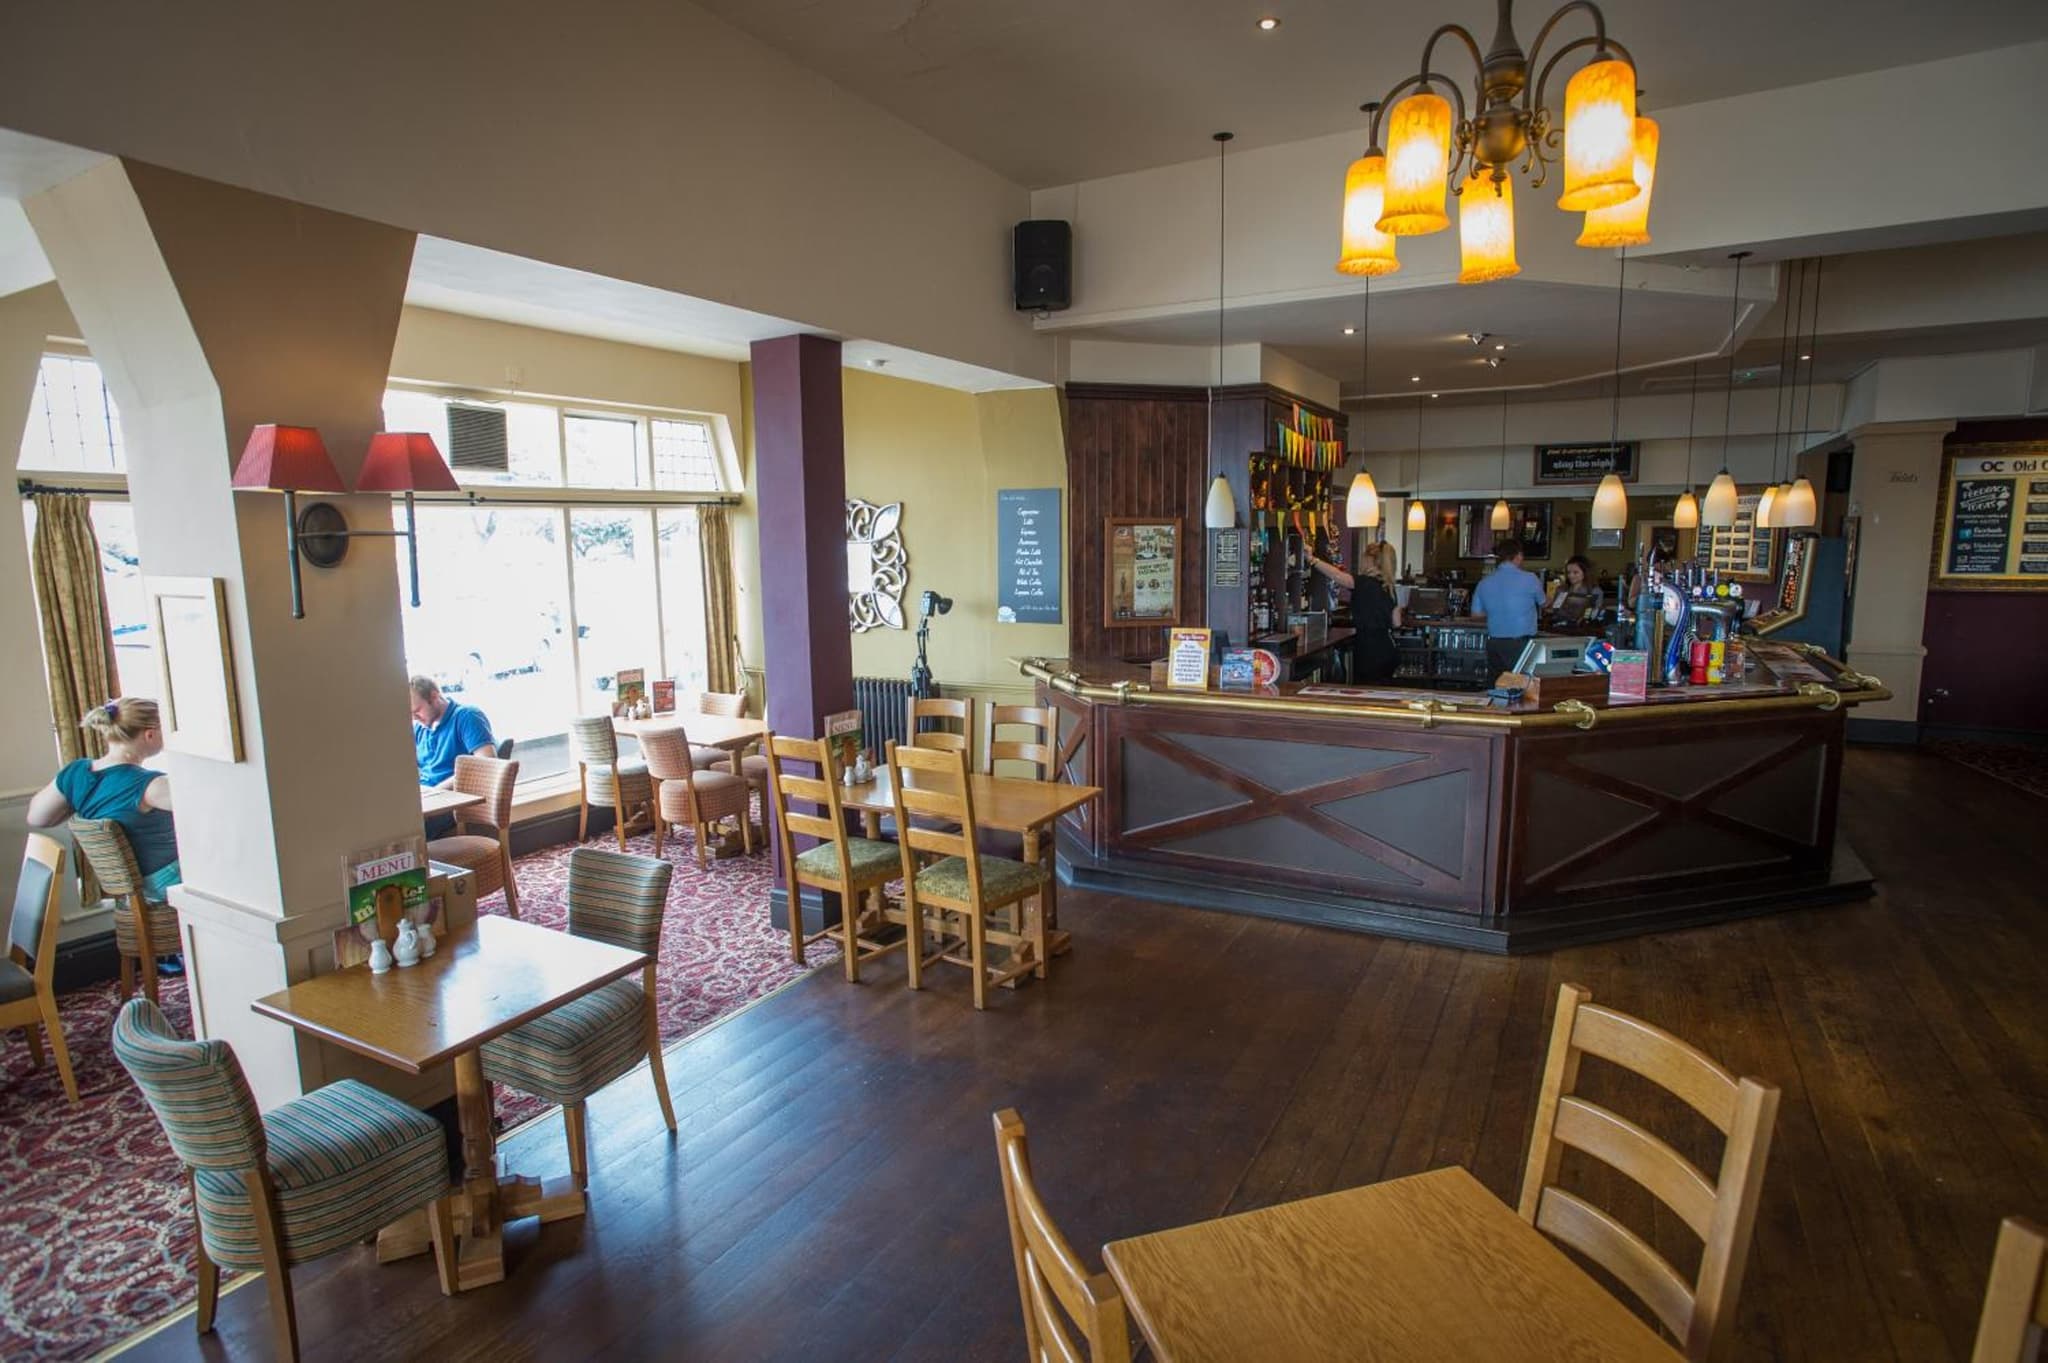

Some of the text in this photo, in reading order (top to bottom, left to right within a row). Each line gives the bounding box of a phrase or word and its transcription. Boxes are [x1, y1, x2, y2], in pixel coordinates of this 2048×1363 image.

[1575, 459, 1590, 468] the
[2013, 460, 2037, 471] Old
[361, 856, 411, 881] MENU
